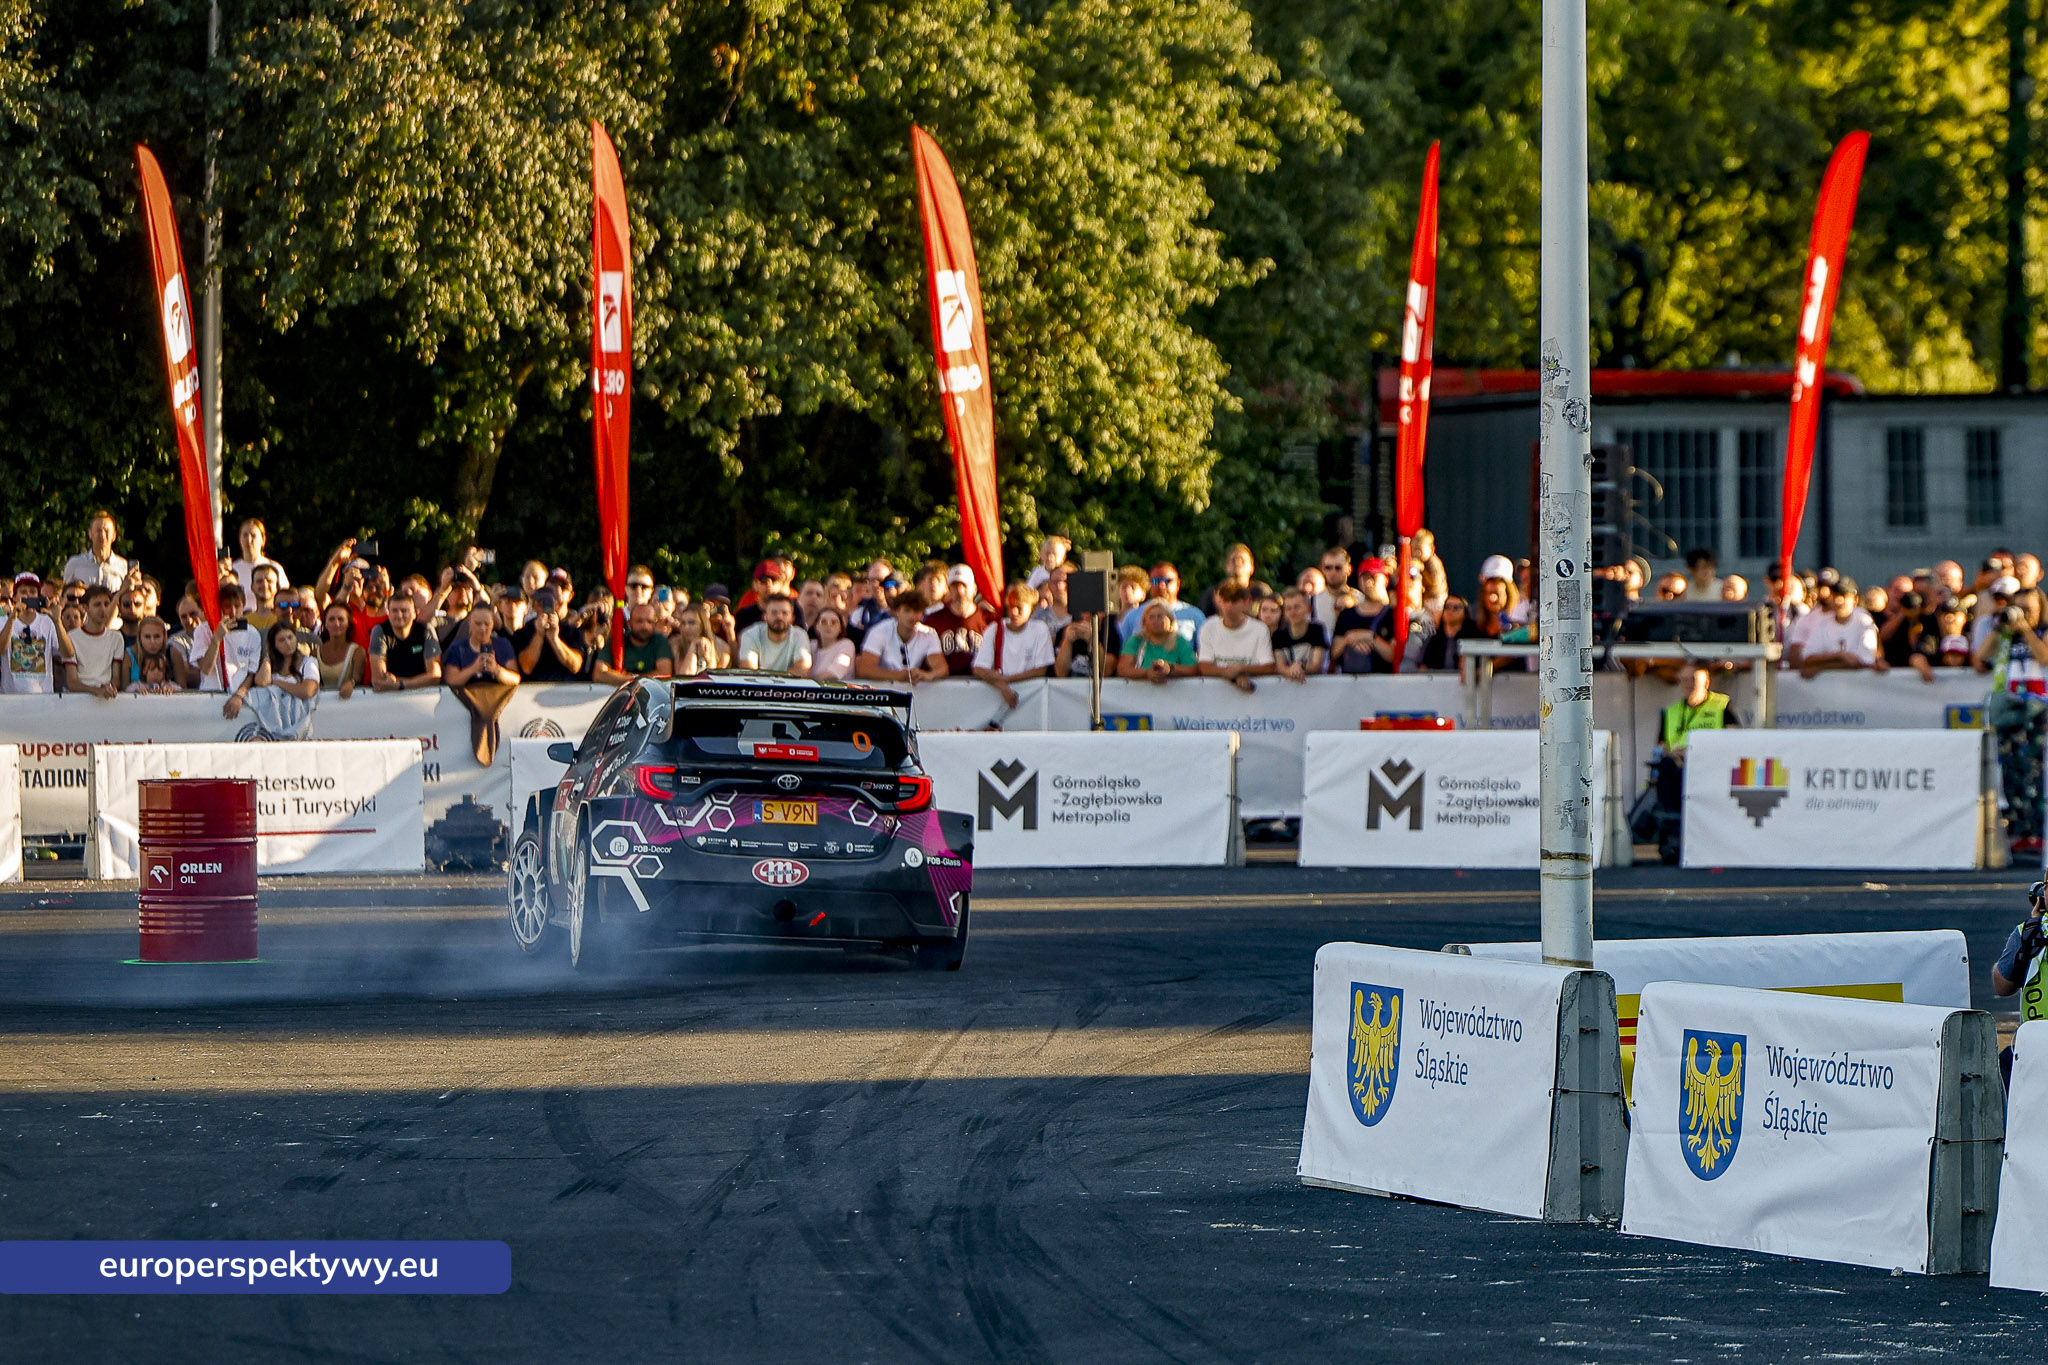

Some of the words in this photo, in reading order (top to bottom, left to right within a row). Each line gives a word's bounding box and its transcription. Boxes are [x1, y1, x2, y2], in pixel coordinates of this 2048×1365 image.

[698, 687, 890, 702] www.tradepolgroup.com
[852, 731, 873, 752] 0
[1052, 775, 1141, 791] Górnośląsko
[1438, 775, 1522, 792] Górnośląsko
[1804, 768, 1936, 791] KATOWICE
[292, 795, 377, 818] Turystyki
[763, 803, 775, 820] S
[781, 804, 815, 822] V9N
[1805, 796, 1824, 811] dla
[1827, 797, 1880, 814] odmiany
[1052, 810, 1131, 826] Metropolia
[1436, 811, 1511, 827] Metropolia
[633, 845, 673, 854] FOB-Decor
[180, 862, 222, 874] ORLEN
[926, 856, 961, 867] FOB-Glass
[180, 875, 196, 884] OIL
[1419, 998, 1523, 1043] Województwo
[1415, 1042, 1469, 1090] Śląskie
[1765, 1044, 1894, 1091] Województwo
[1762, 1091, 1828, 1141] Śląskie
